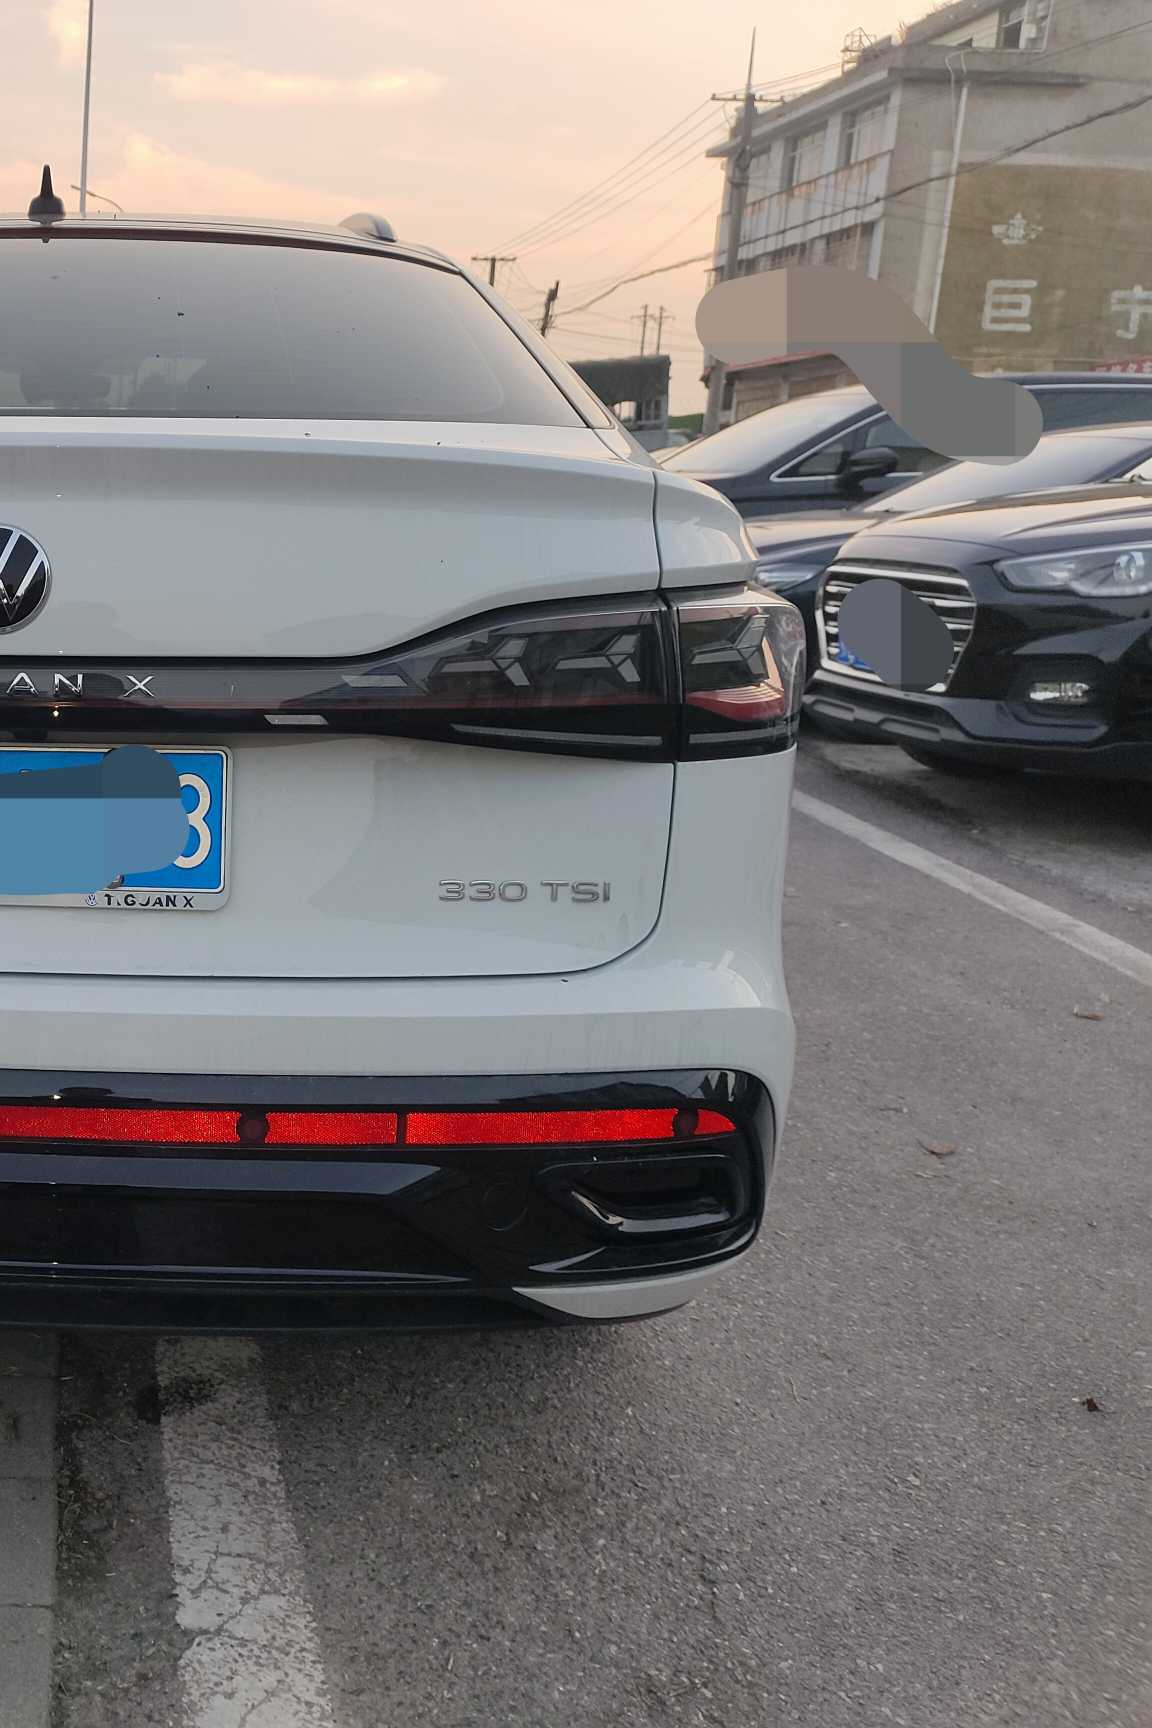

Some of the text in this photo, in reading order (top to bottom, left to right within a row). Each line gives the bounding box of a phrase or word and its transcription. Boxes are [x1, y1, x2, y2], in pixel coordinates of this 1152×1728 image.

[125, 674, 156, 698] X
[438, 879, 611, 903] 330 TSI
